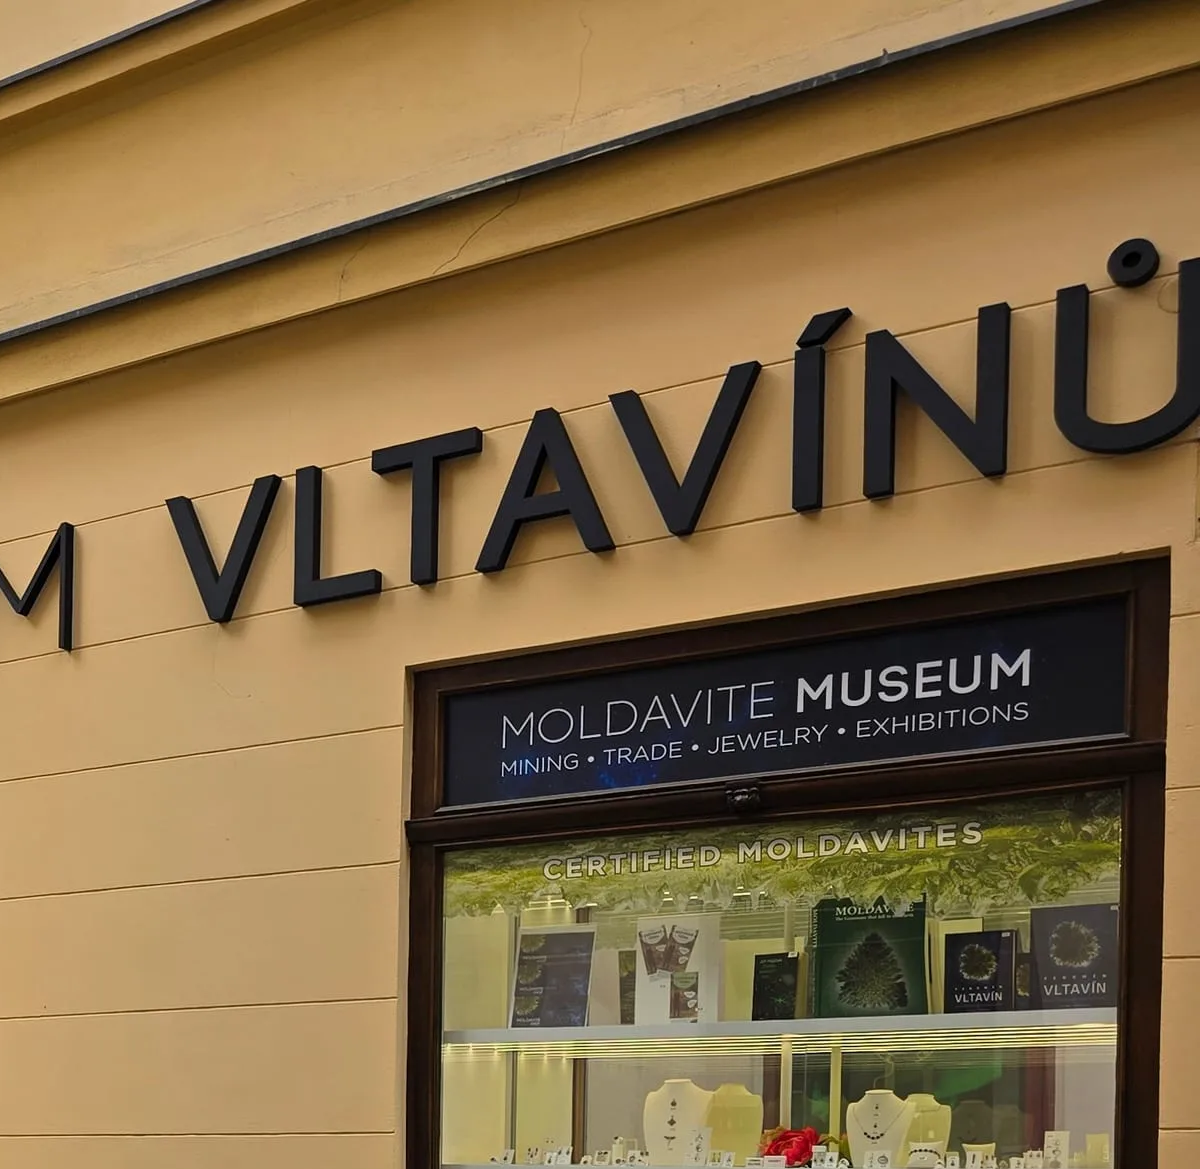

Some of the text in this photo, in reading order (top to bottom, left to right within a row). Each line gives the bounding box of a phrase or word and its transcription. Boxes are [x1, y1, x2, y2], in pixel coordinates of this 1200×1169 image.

[166, 237, 1200, 624] VLTAVÍNŮ
[501, 648, 1031, 749] MOLDAVITE MUSEUM
[501, 702, 1029, 777] MINING TRADE JEWELRY EXHIBITIONS
[542, 821, 983, 880] CERTIFIED MOLDAVITES
[835, 904, 914, 916] MOLDAVE
[955, 990, 1002, 1003] VLTAVÍN
[1043, 980, 1106, 996] VLTAVÍN
